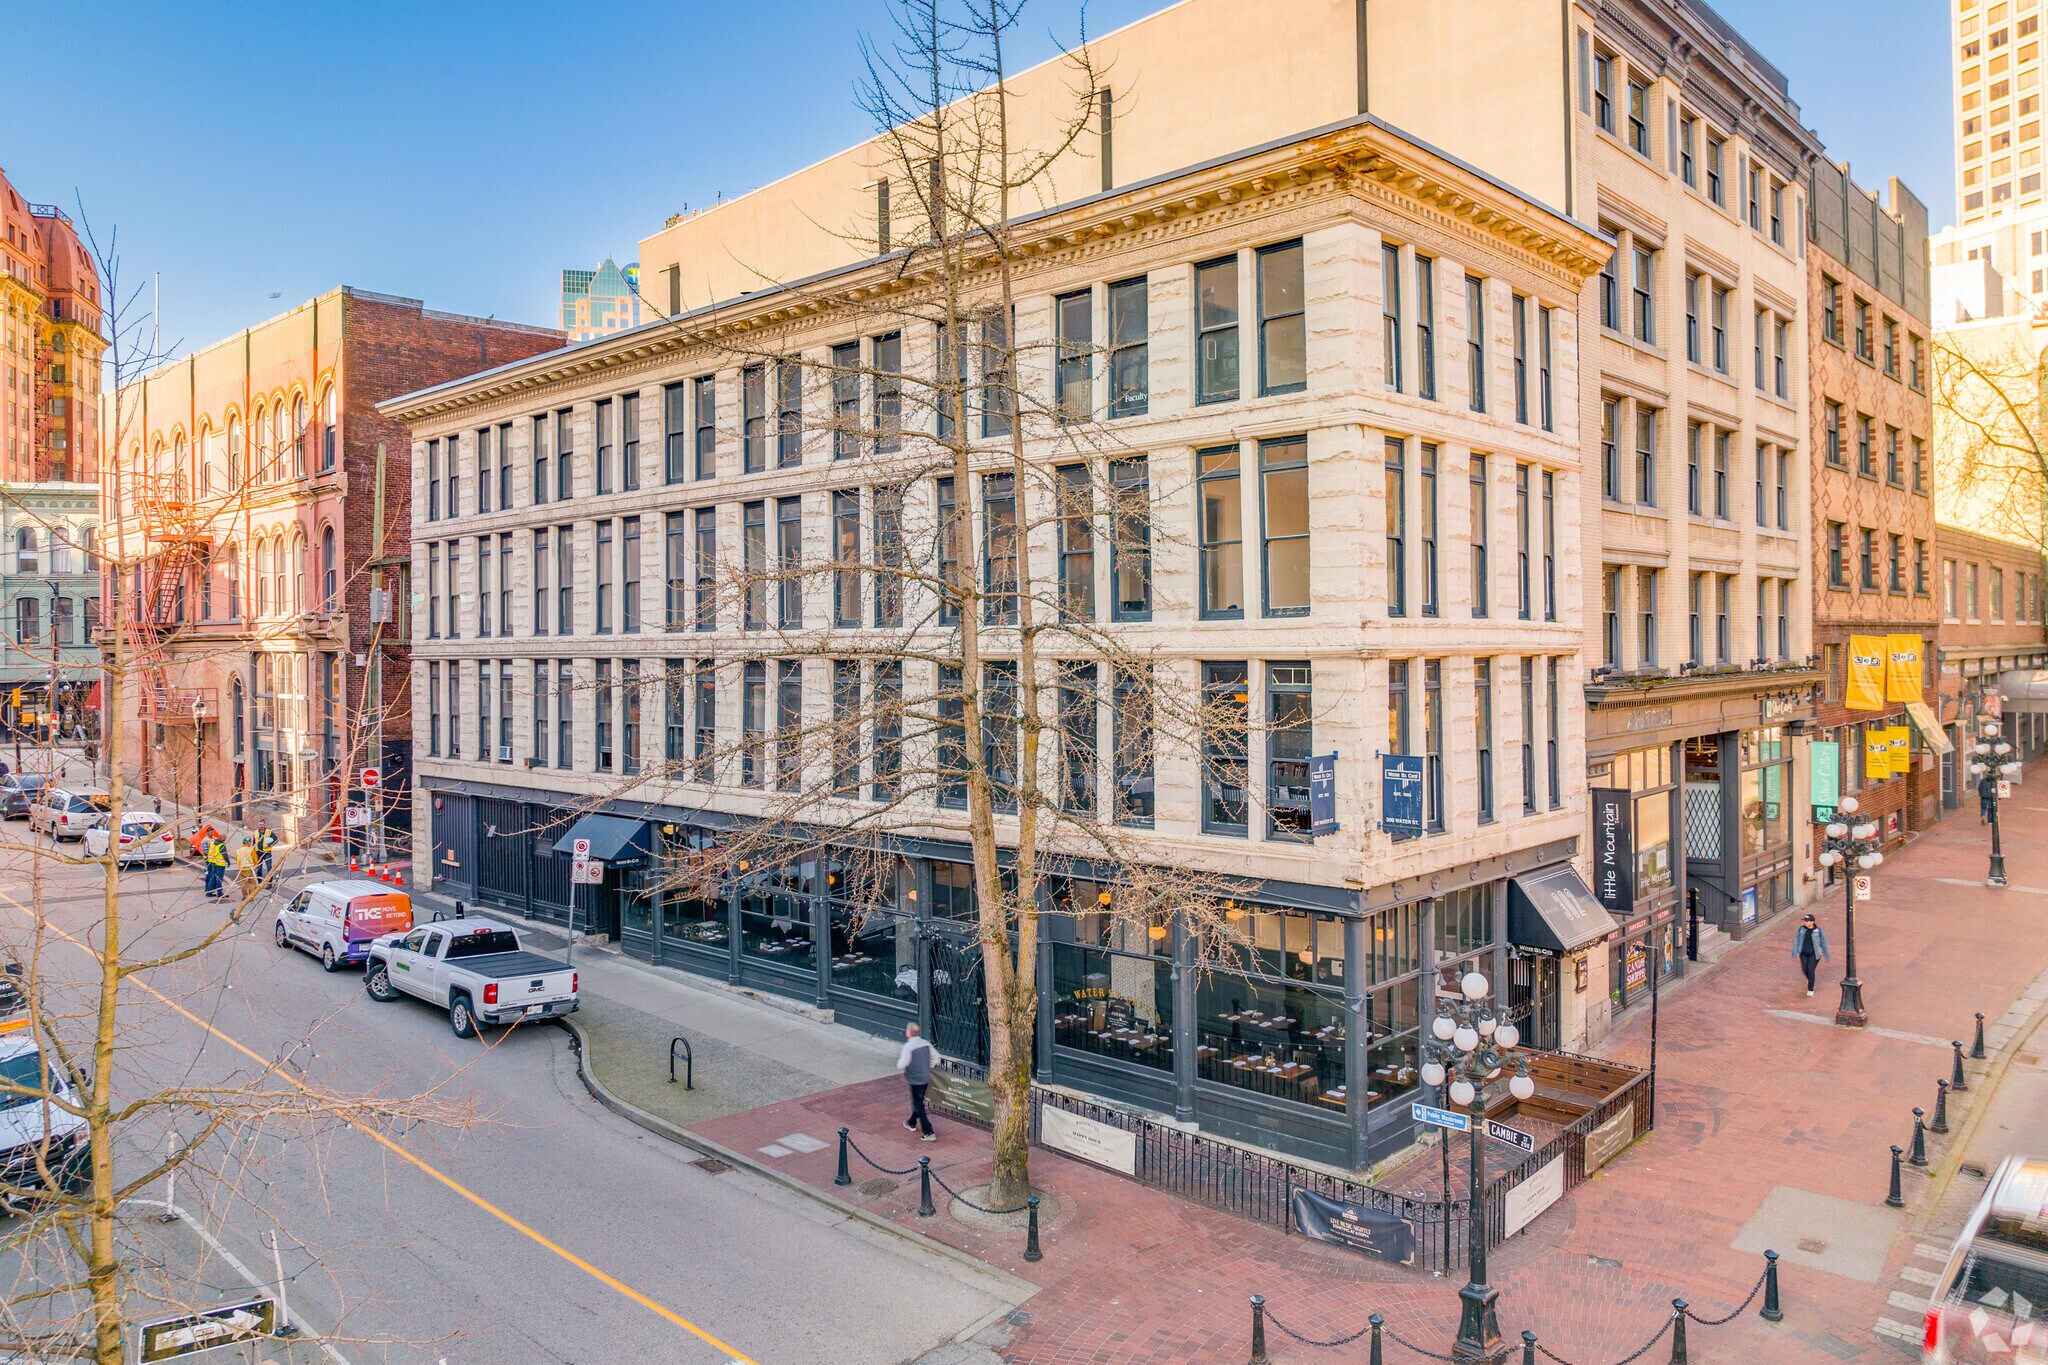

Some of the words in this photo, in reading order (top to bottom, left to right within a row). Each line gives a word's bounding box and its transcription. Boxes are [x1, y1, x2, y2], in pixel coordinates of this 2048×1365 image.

[1394, 817, 1411, 825] WATER
[1603, 803, 1616, 865] Mountain
[1604, 870, 1616, 899] little
[354, 907, 382, 921] TKE
[382, 905, 397, 913] MOVE
[385, 911, 407, 919] BEYOND
[1629, 920, 1646, 932] NOVELTY
[1626, 957, 1646, 974] CANDY
[1626, 968, 1646, 986] SHOPPE
[1073, 987, 1105, 1000] WATER
[1426, 1110, 1440, 1120] Public
[1441, 1114, 1464, 1125] Washroom
[1491, 1124, 1518, 1144] CAMBIE
[1520, 1140, 1530, 1149] 200
[1330, 1217, 1340, 1226] LIVE
[1340, 1219, 1353, 1230] MUSIC
[1352, 1223, 1372, 1236] NIGHTLY
